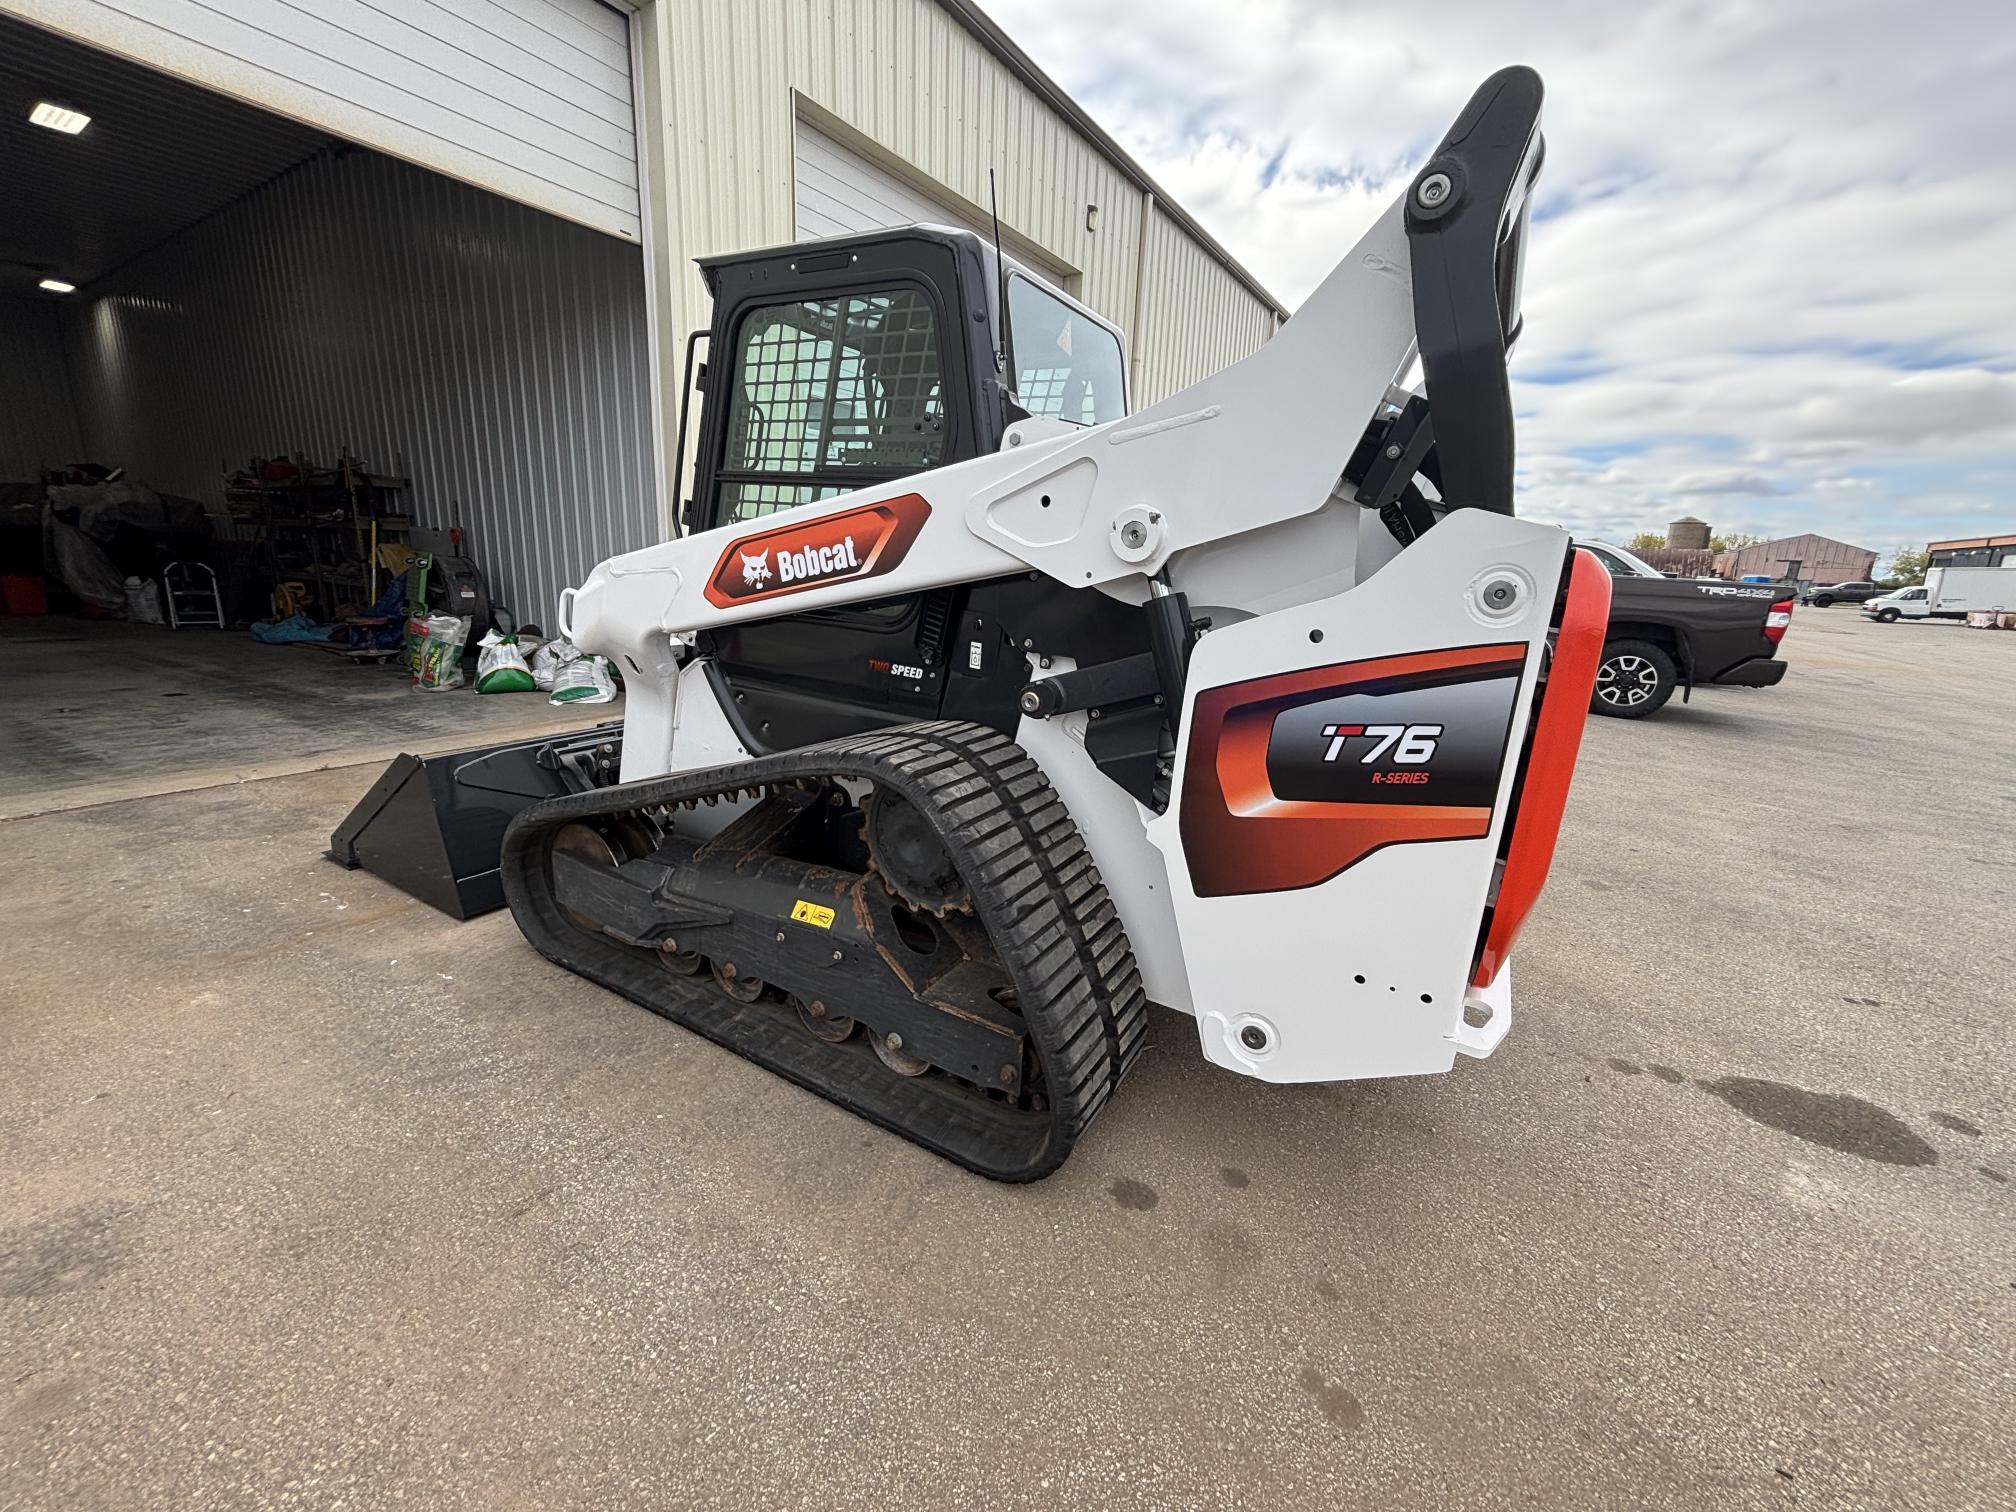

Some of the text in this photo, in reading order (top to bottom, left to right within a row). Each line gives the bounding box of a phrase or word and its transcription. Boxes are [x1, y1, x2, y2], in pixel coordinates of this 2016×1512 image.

[777, 536, 857, 582] Bobcat
[868, 659, 923, 679] TWO SPEED
[1321, 724, 1445, 764] T76
[1372, 772, 1430, 784] R-SERIES
